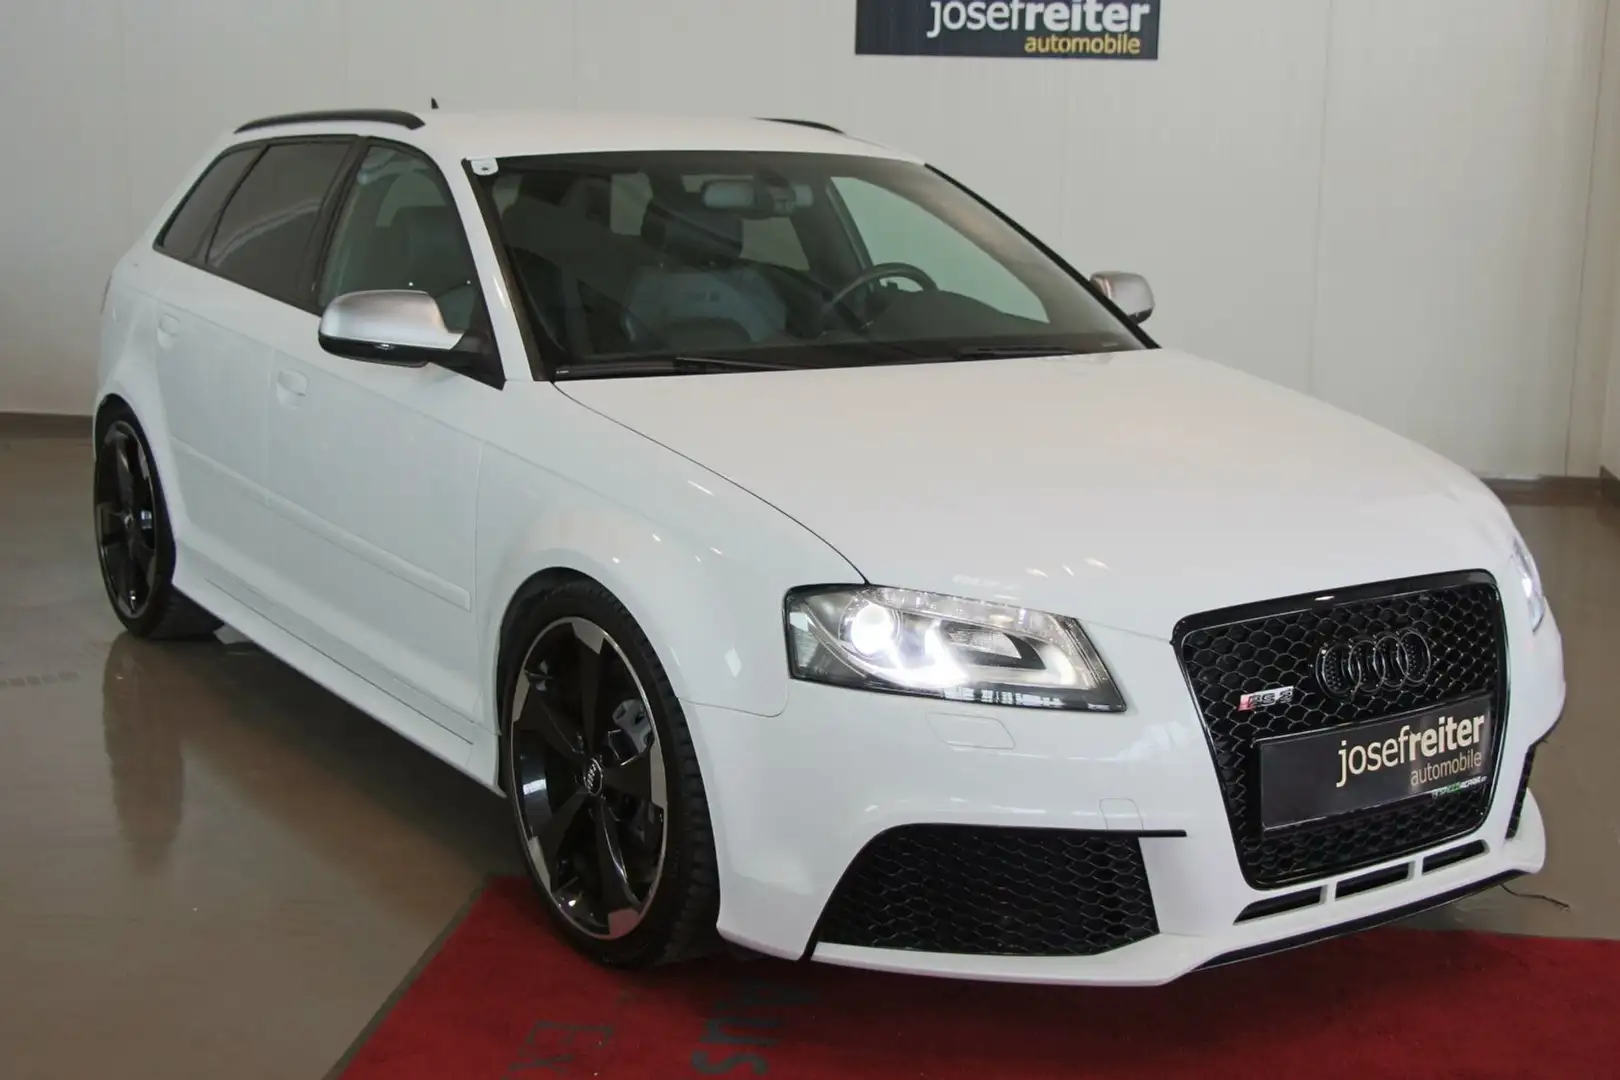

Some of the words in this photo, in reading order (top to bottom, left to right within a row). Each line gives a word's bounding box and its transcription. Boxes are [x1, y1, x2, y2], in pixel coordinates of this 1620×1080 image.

[926, 0, 1150, 39] josefreiter
[1024, 32, 1141, 55] automobile
[1336, 714, 1485, 788] josefreiter
[1410, 748, 1482, 787] automobile
